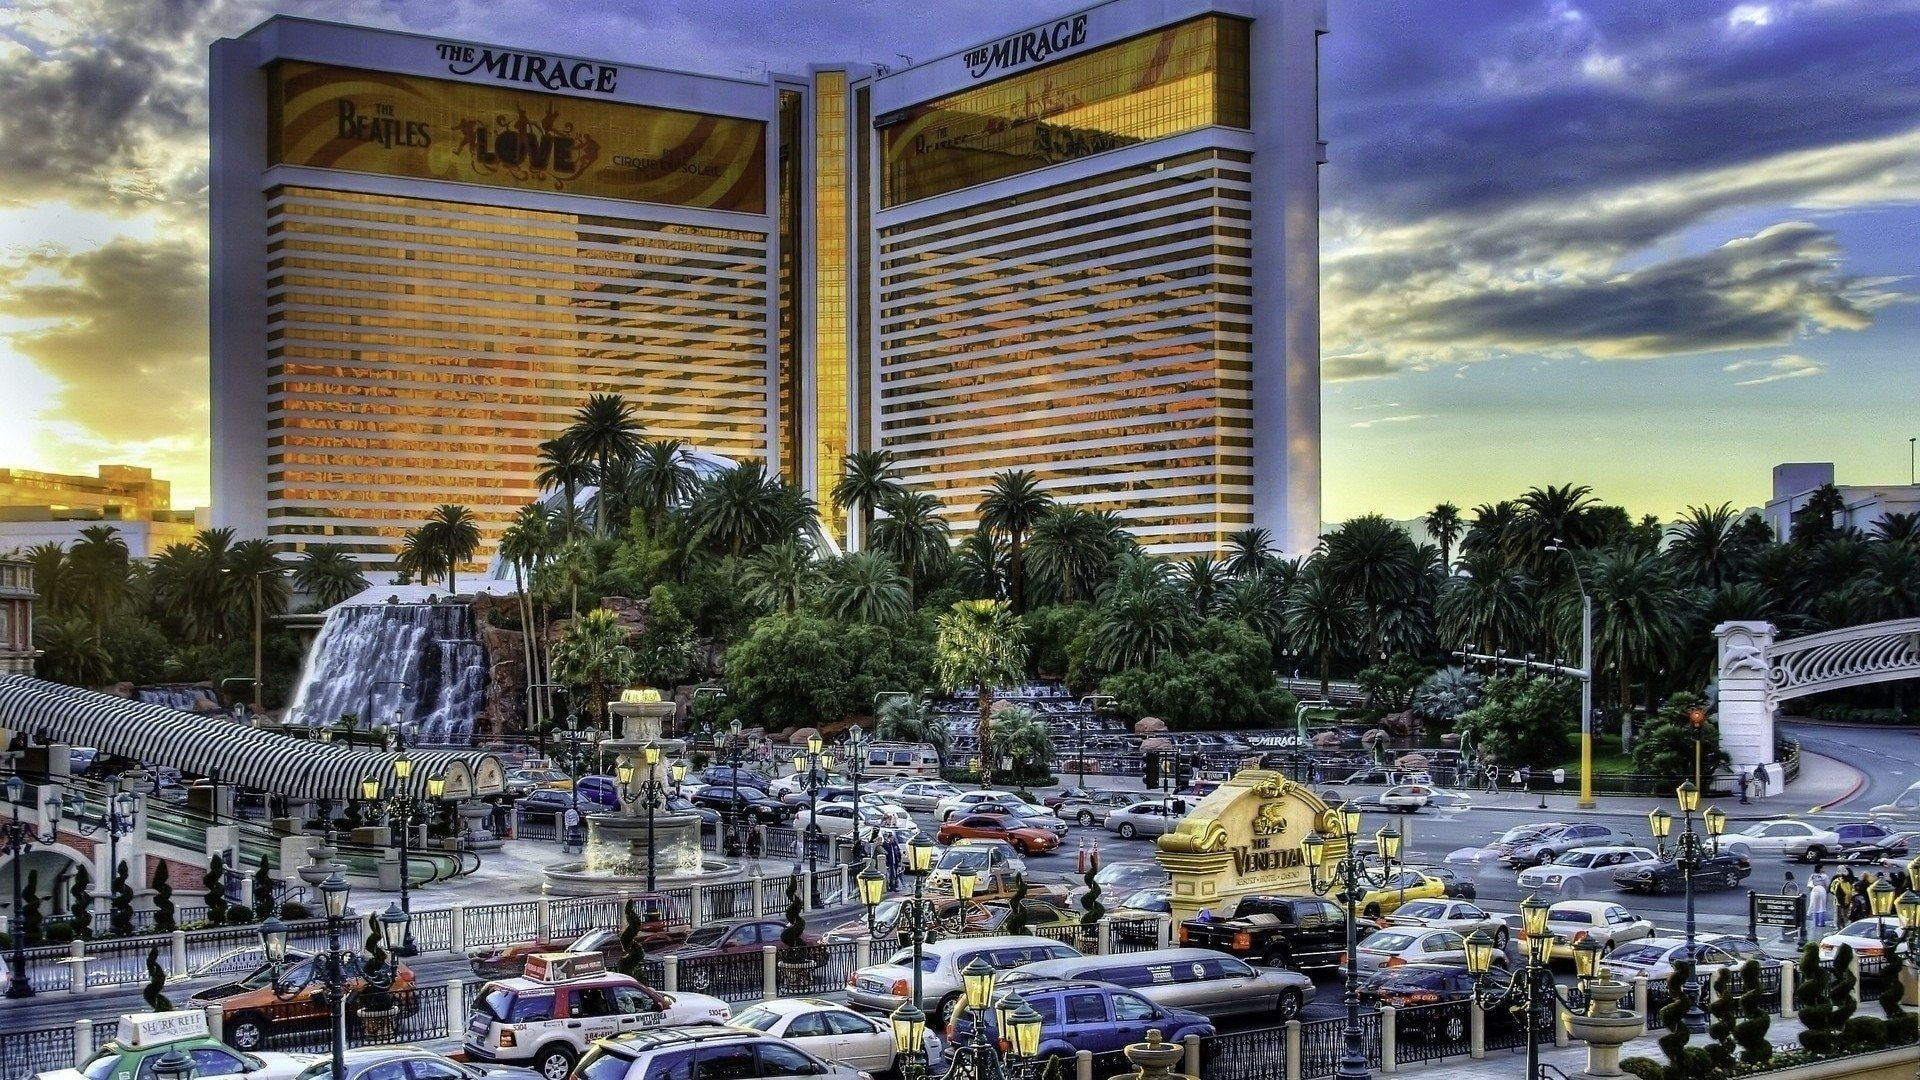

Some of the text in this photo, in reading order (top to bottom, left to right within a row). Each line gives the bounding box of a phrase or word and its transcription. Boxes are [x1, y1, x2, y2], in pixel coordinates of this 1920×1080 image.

[436, 44, 618, 93] THE MIRAGE
[962, 13, 1087, 78] THE MIRAGE
[337, 97, 432, 149] BEATLES
[376, 101, 394, 117] THE
[474, 126, 577, 174] LOVE
[1251, 838, 1271, 850] THE
